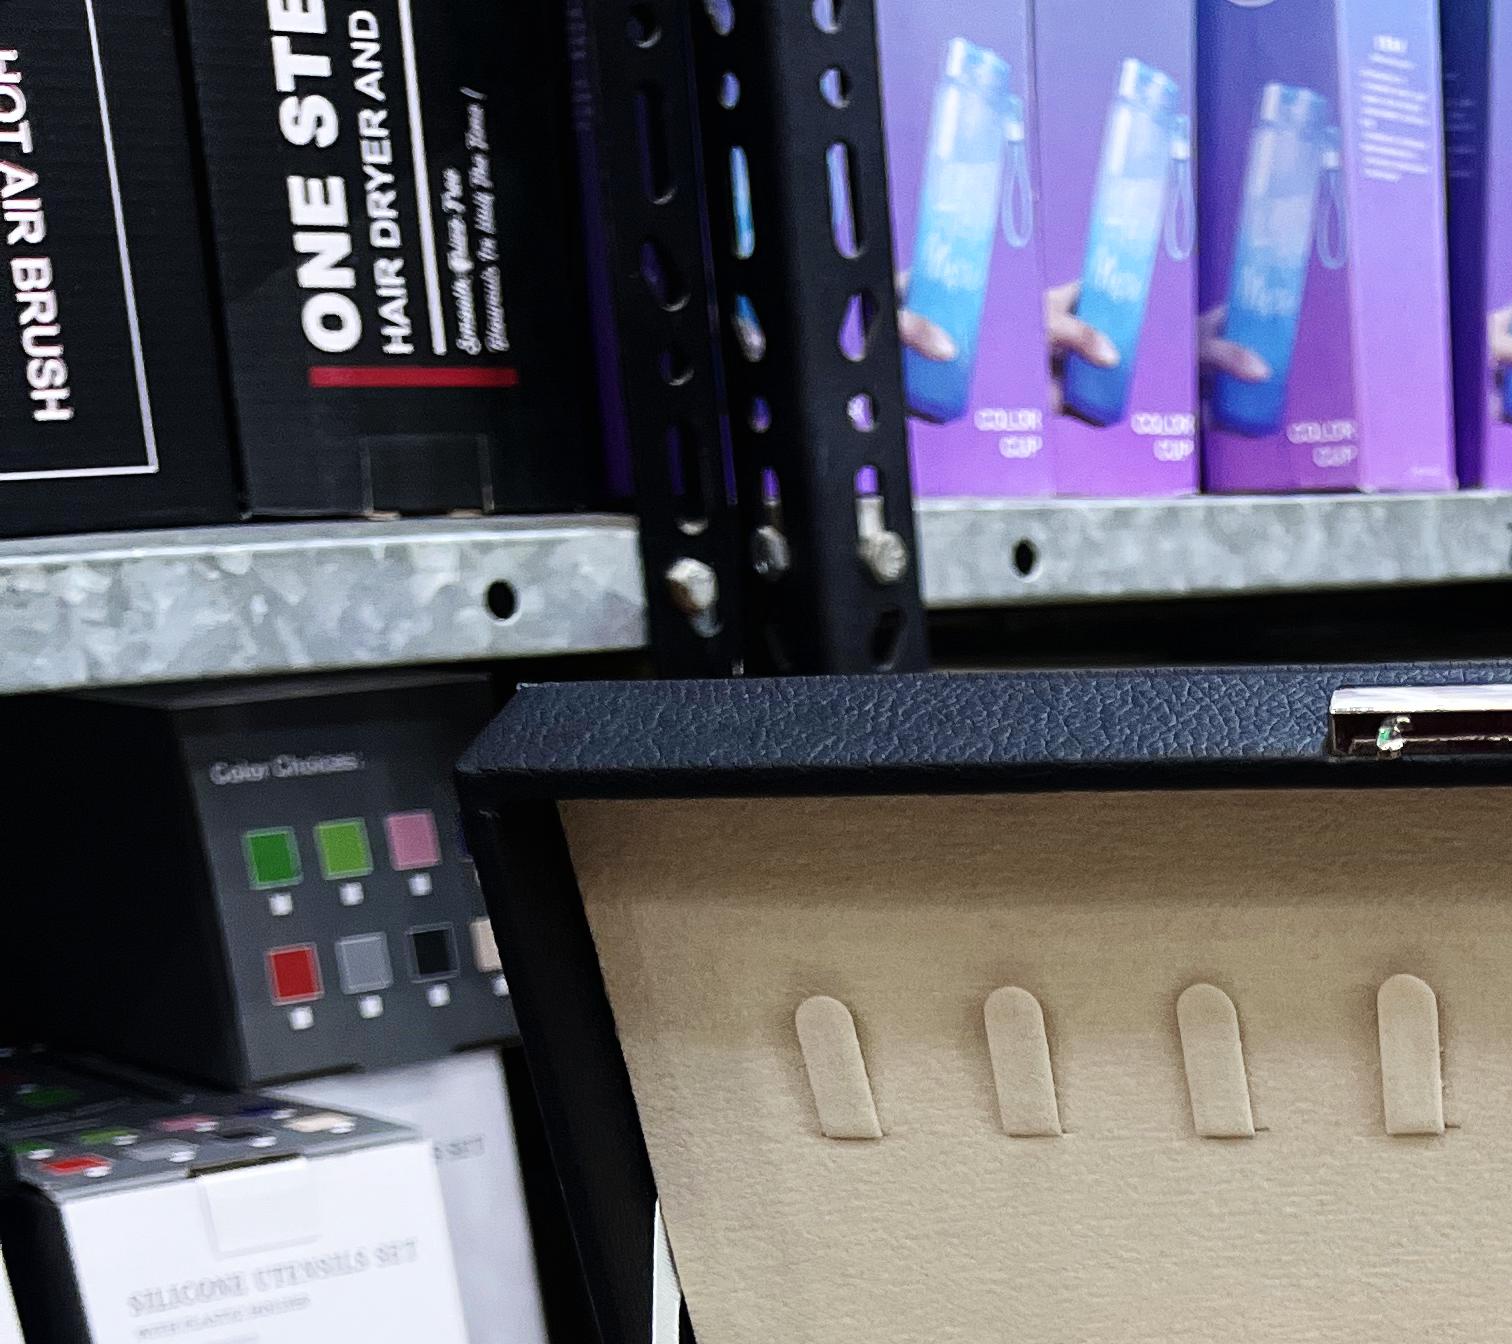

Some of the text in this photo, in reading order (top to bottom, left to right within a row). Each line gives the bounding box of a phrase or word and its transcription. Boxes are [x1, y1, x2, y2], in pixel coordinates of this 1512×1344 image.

[0, 160, 47, 246] AIR
[286, 175, 363, 353] ONE
[348, 10, 415, 354] HAIR DRYER AND
[10, 257, 75, 421] BRUSH
